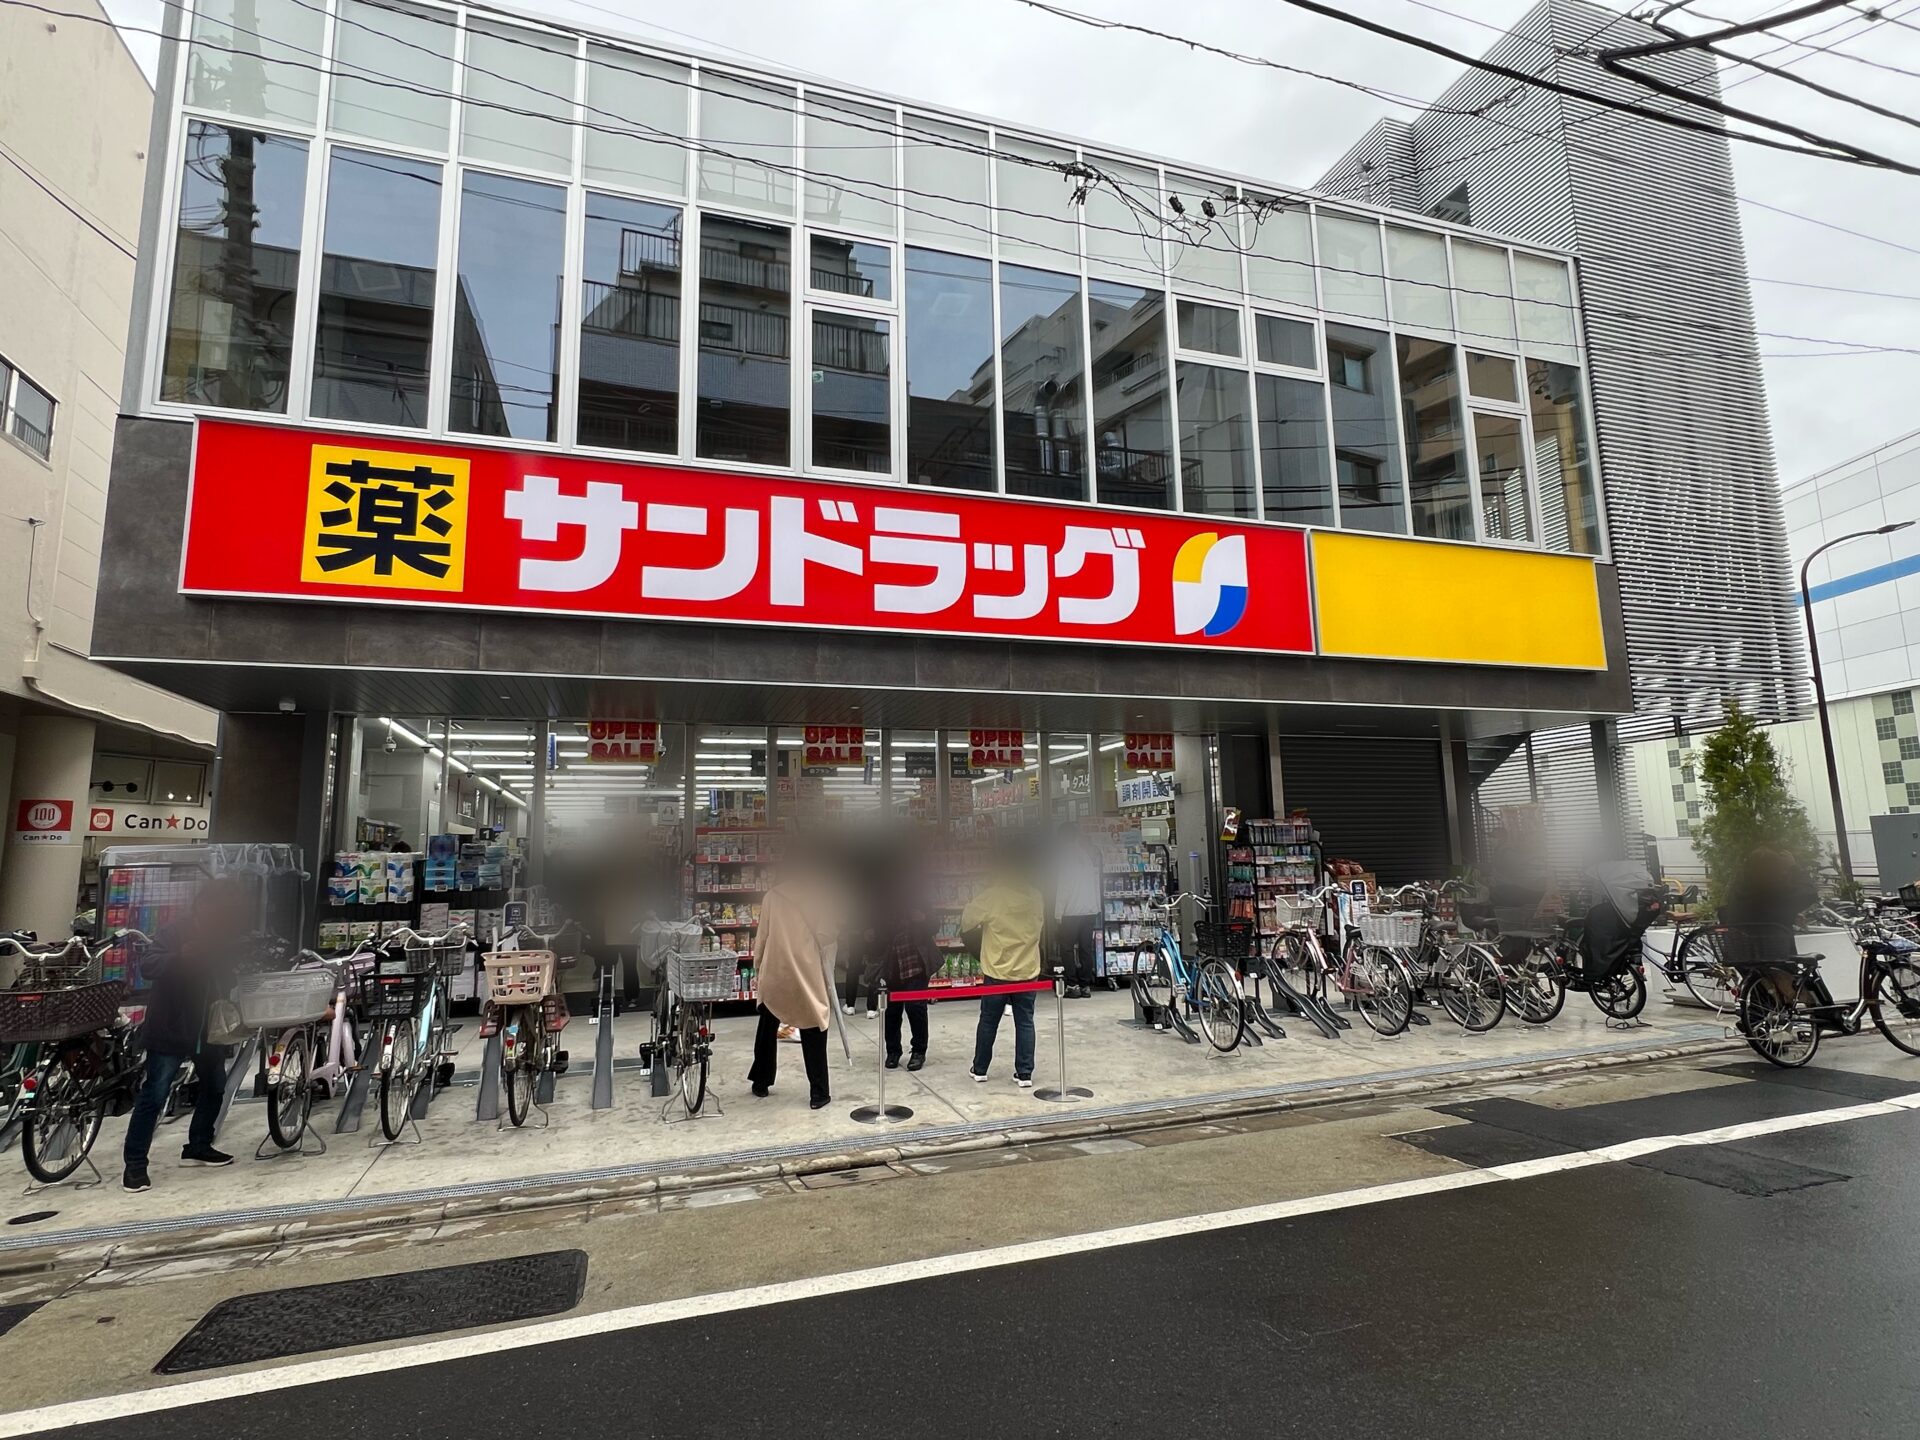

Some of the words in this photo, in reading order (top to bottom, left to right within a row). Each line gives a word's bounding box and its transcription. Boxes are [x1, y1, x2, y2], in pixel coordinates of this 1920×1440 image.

[314, 459, 455, 579] 薬
[504, 474, 1146, 625] サンドラッグ
[590, 721, 657, 740] OPEN
[805, 726, 864, 744] OPEN
[970, 730, 1023, 747] OPEN
[1125, 733, 1173, 750] OPEN
[591, 742, 656, 762] SALE
[806, 746, 863, 764] SALE
[972, 749, 1022, 767] SALE
[1126, 752, 1173, 769] SALE
[1122, 780, 1168, 802] 調剤開設
[35, 807, 55, 821] 100
[96, 815, 108, 824] 100
[124, 814, 162, 829] Can
[183, 817, 208, 830] Do
